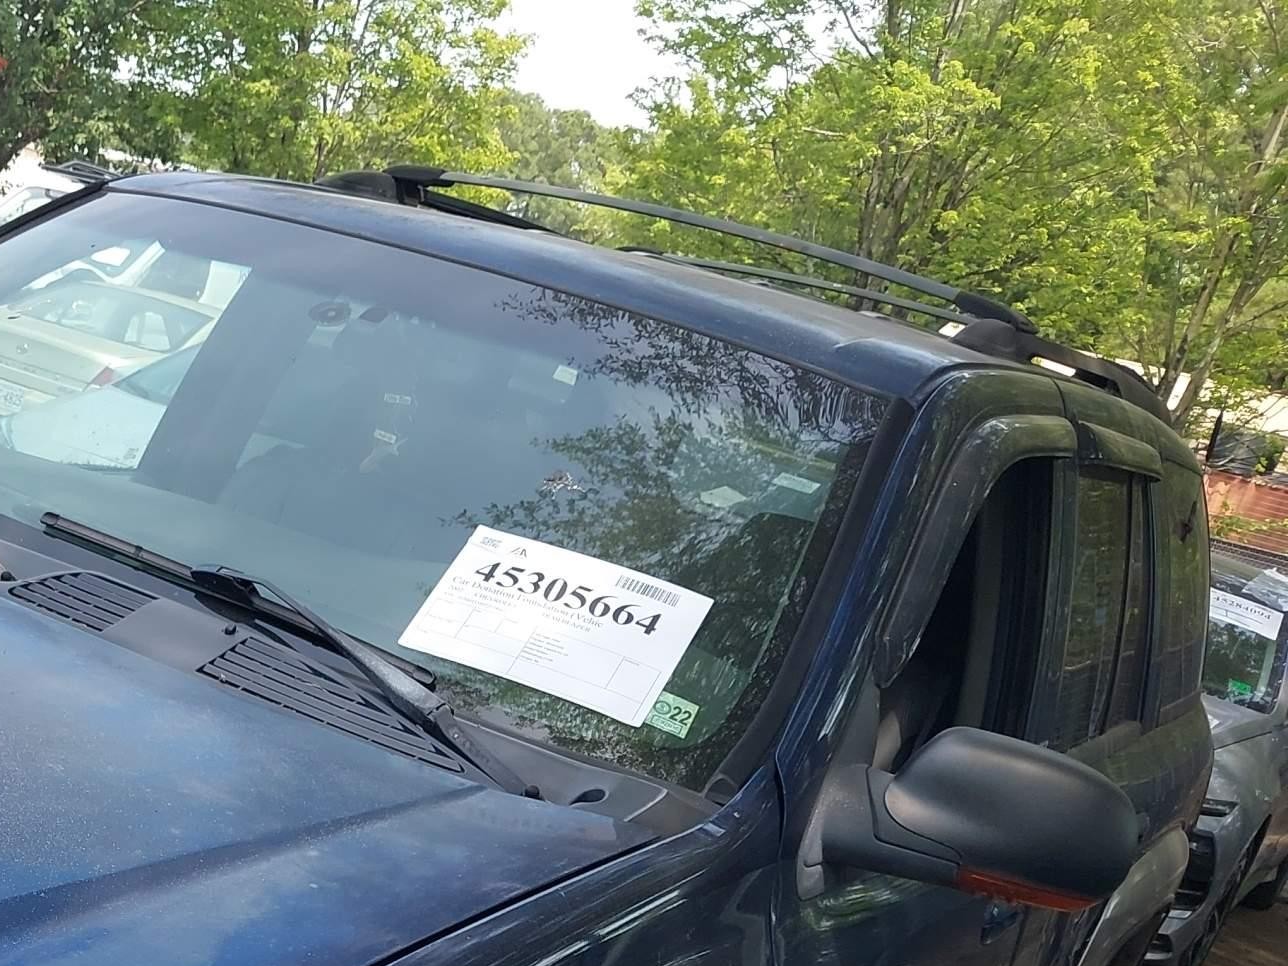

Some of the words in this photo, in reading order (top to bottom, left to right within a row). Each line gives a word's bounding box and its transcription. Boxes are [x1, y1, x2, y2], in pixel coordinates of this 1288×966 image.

[453, 576, 469, 585] Car
[472, 580, 515, 600] Donation
[474, 561, 662, 636] 45305664
[668, 705, 693, 728] 22
